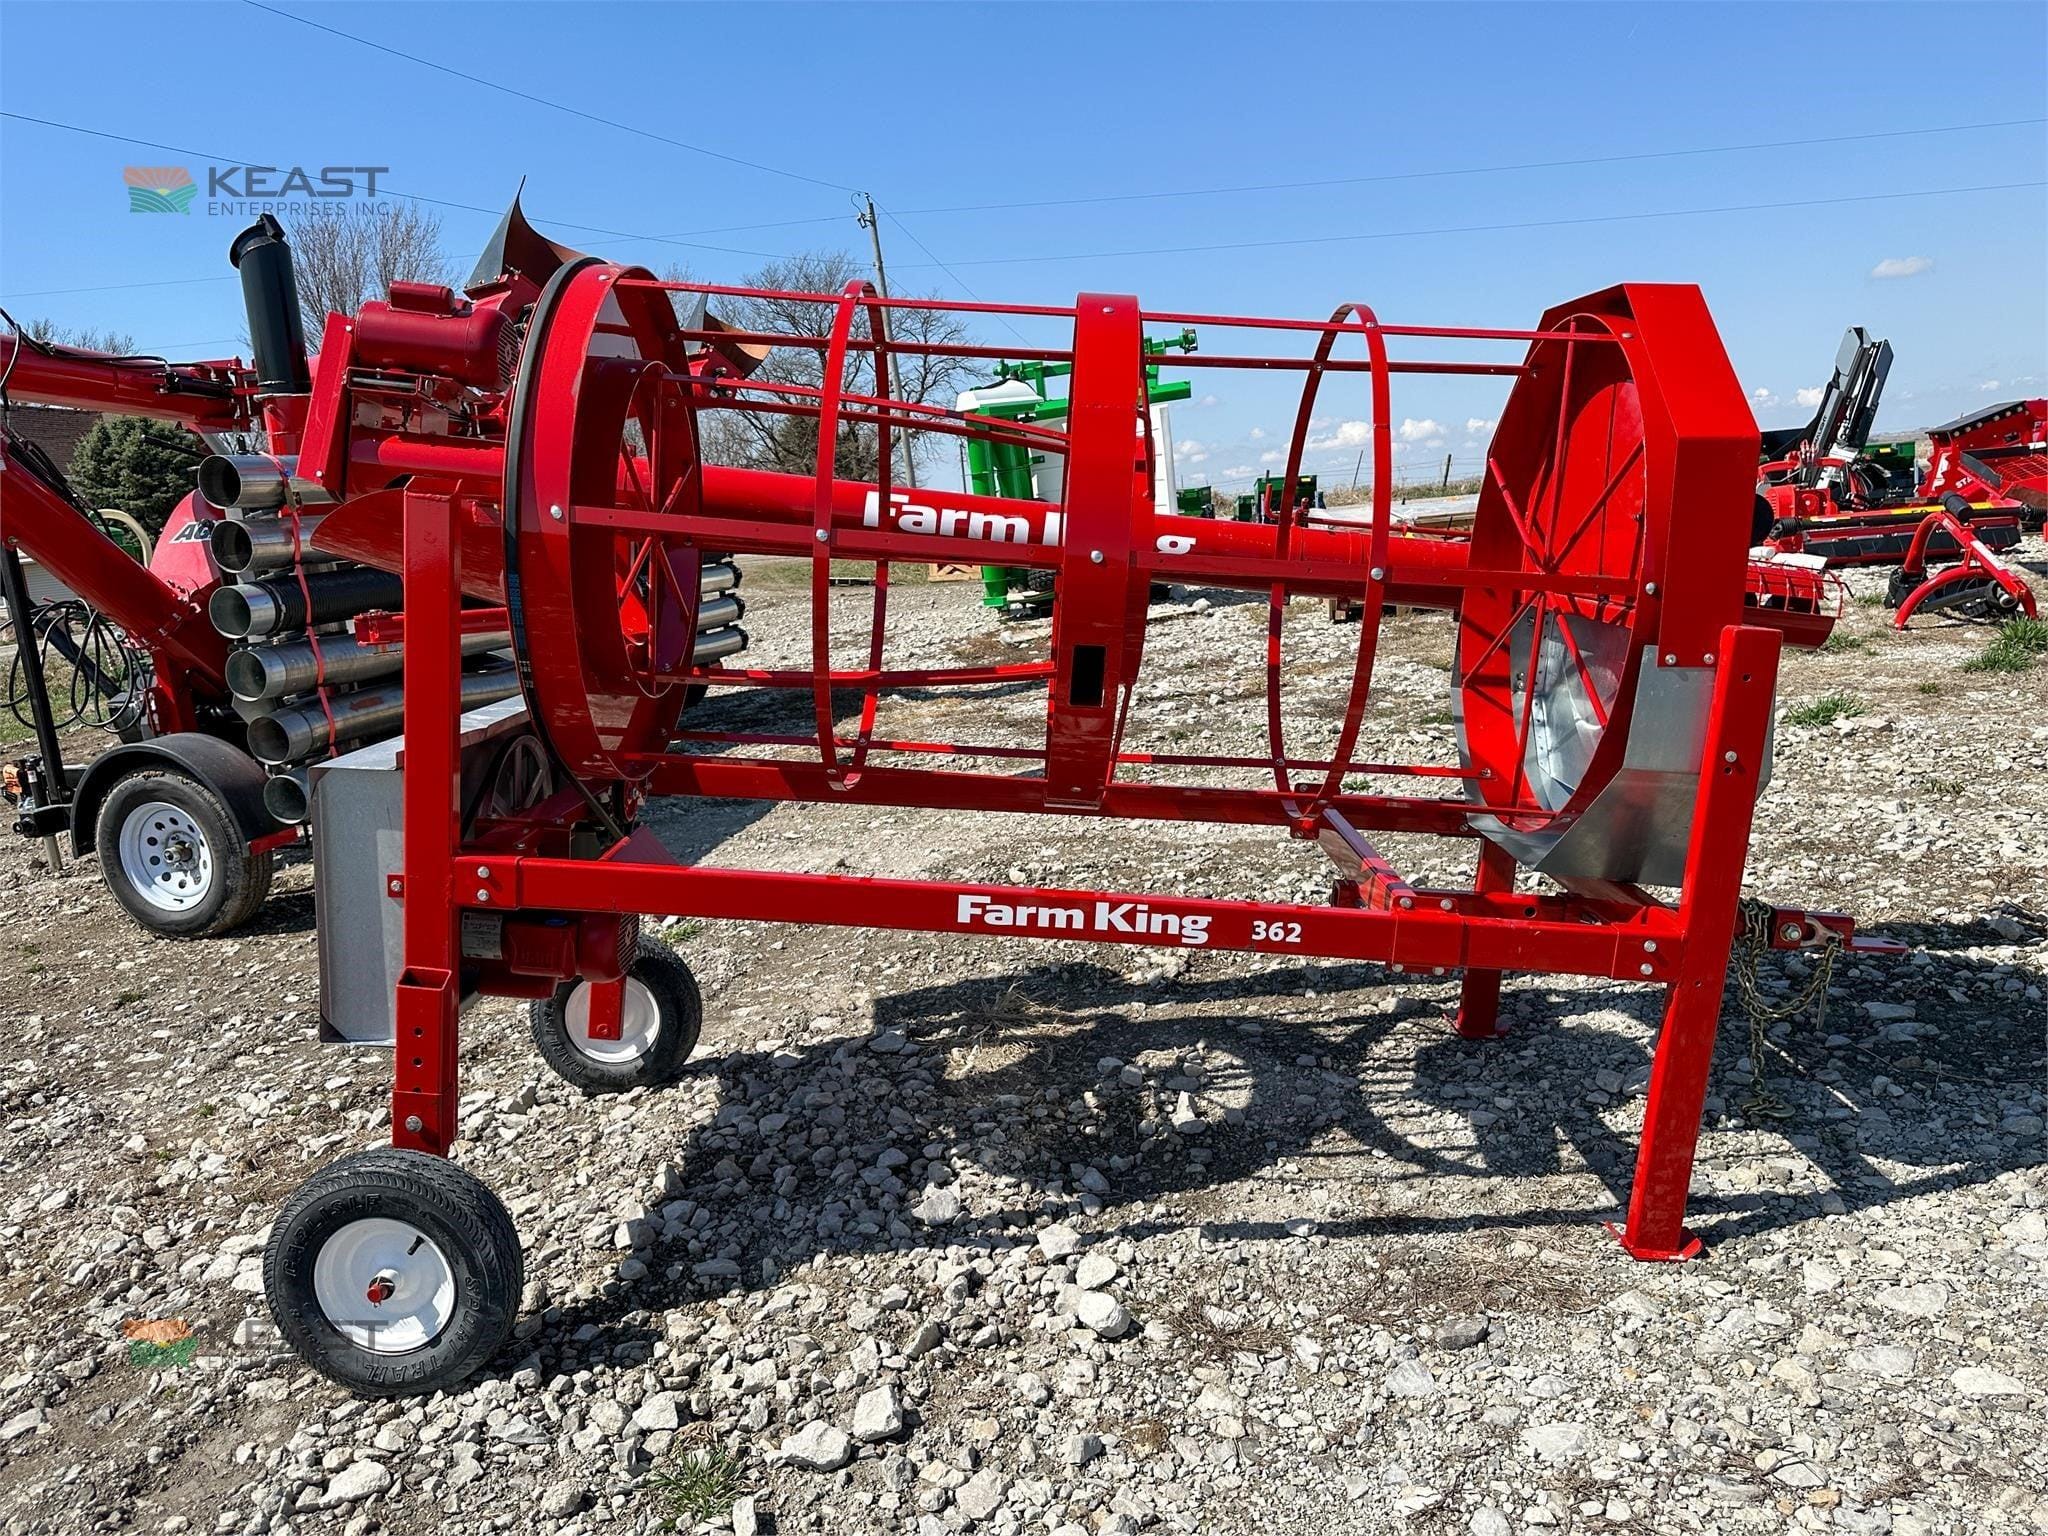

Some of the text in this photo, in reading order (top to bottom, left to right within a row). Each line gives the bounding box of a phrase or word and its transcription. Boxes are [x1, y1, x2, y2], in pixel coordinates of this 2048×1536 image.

[863, 491, 1030, 544] Farm
[957, 894, 1302, 945] Farm King 362
[364, 1354, 443, 1384] TRAIL
